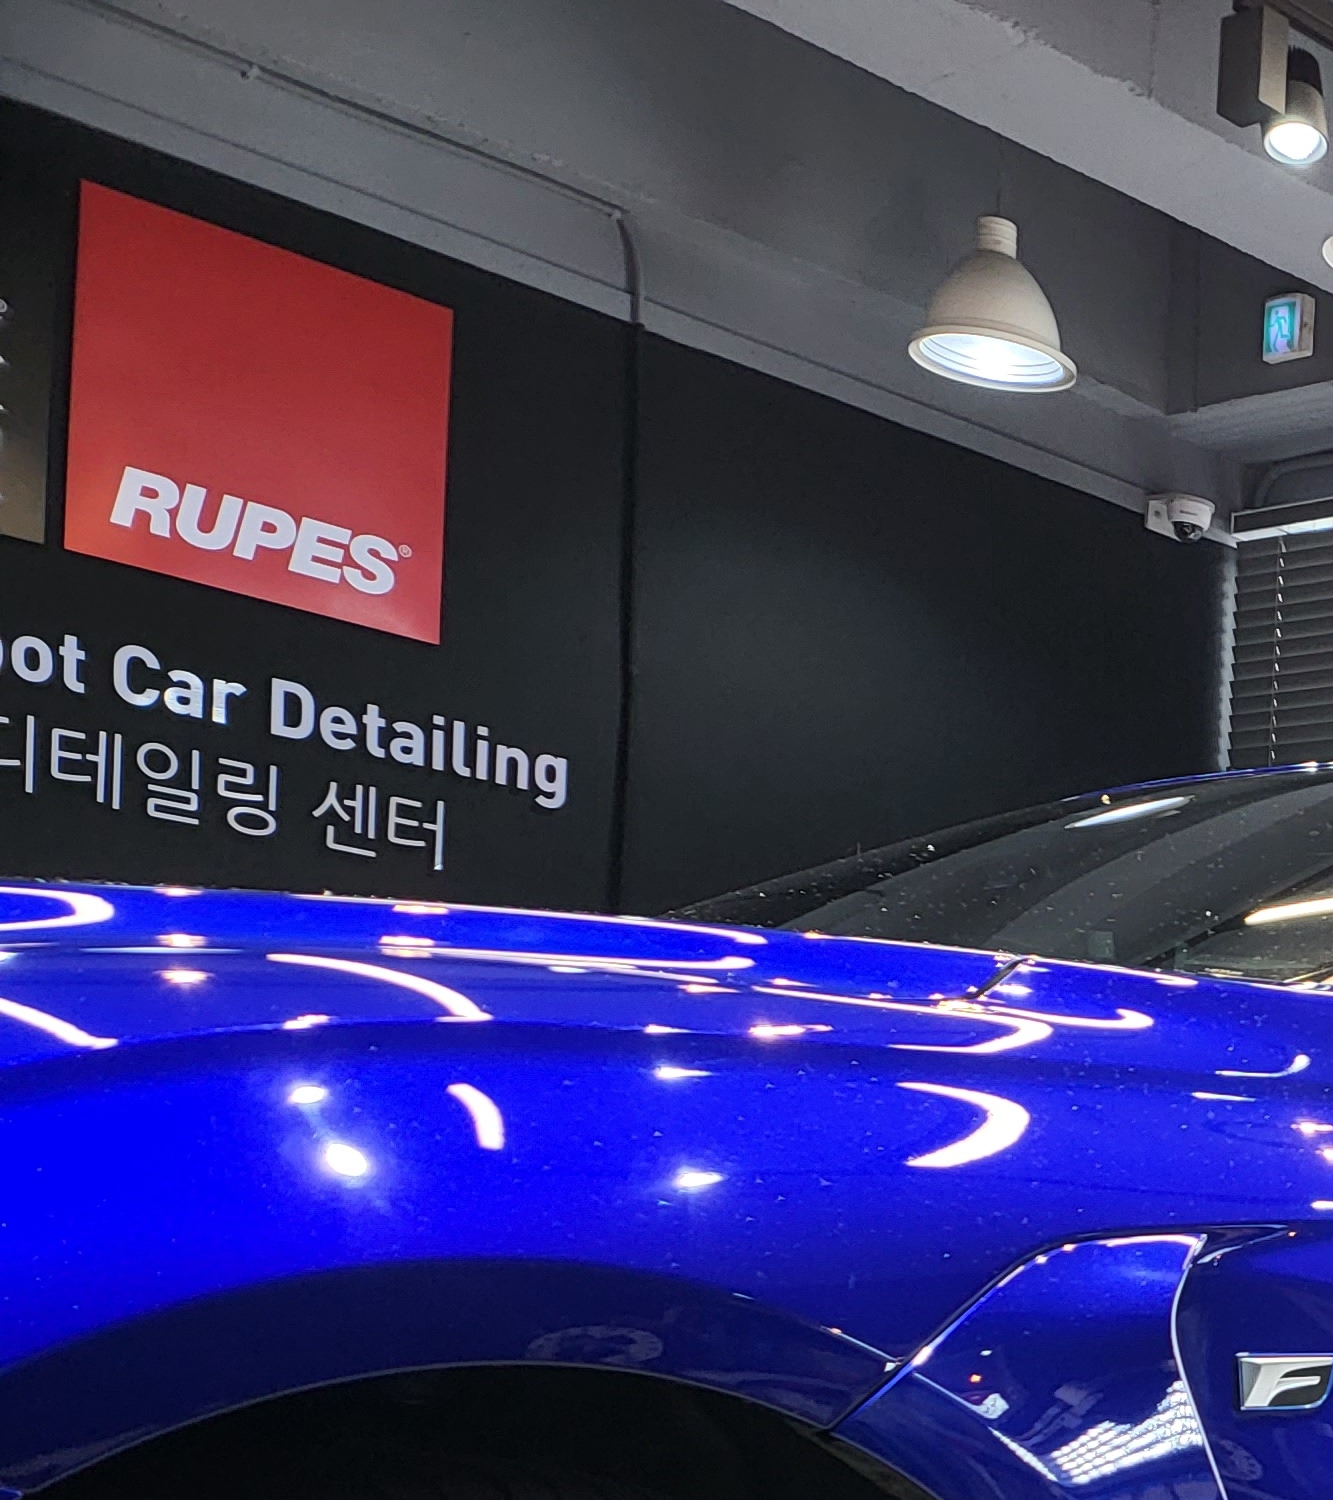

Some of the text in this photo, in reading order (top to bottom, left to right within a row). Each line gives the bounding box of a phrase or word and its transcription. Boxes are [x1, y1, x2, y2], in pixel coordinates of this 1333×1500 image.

[112, 643, 247, 725] Car
[269, 676, 569, 809] Detailing
[311, 780, 445, 871] 센터
